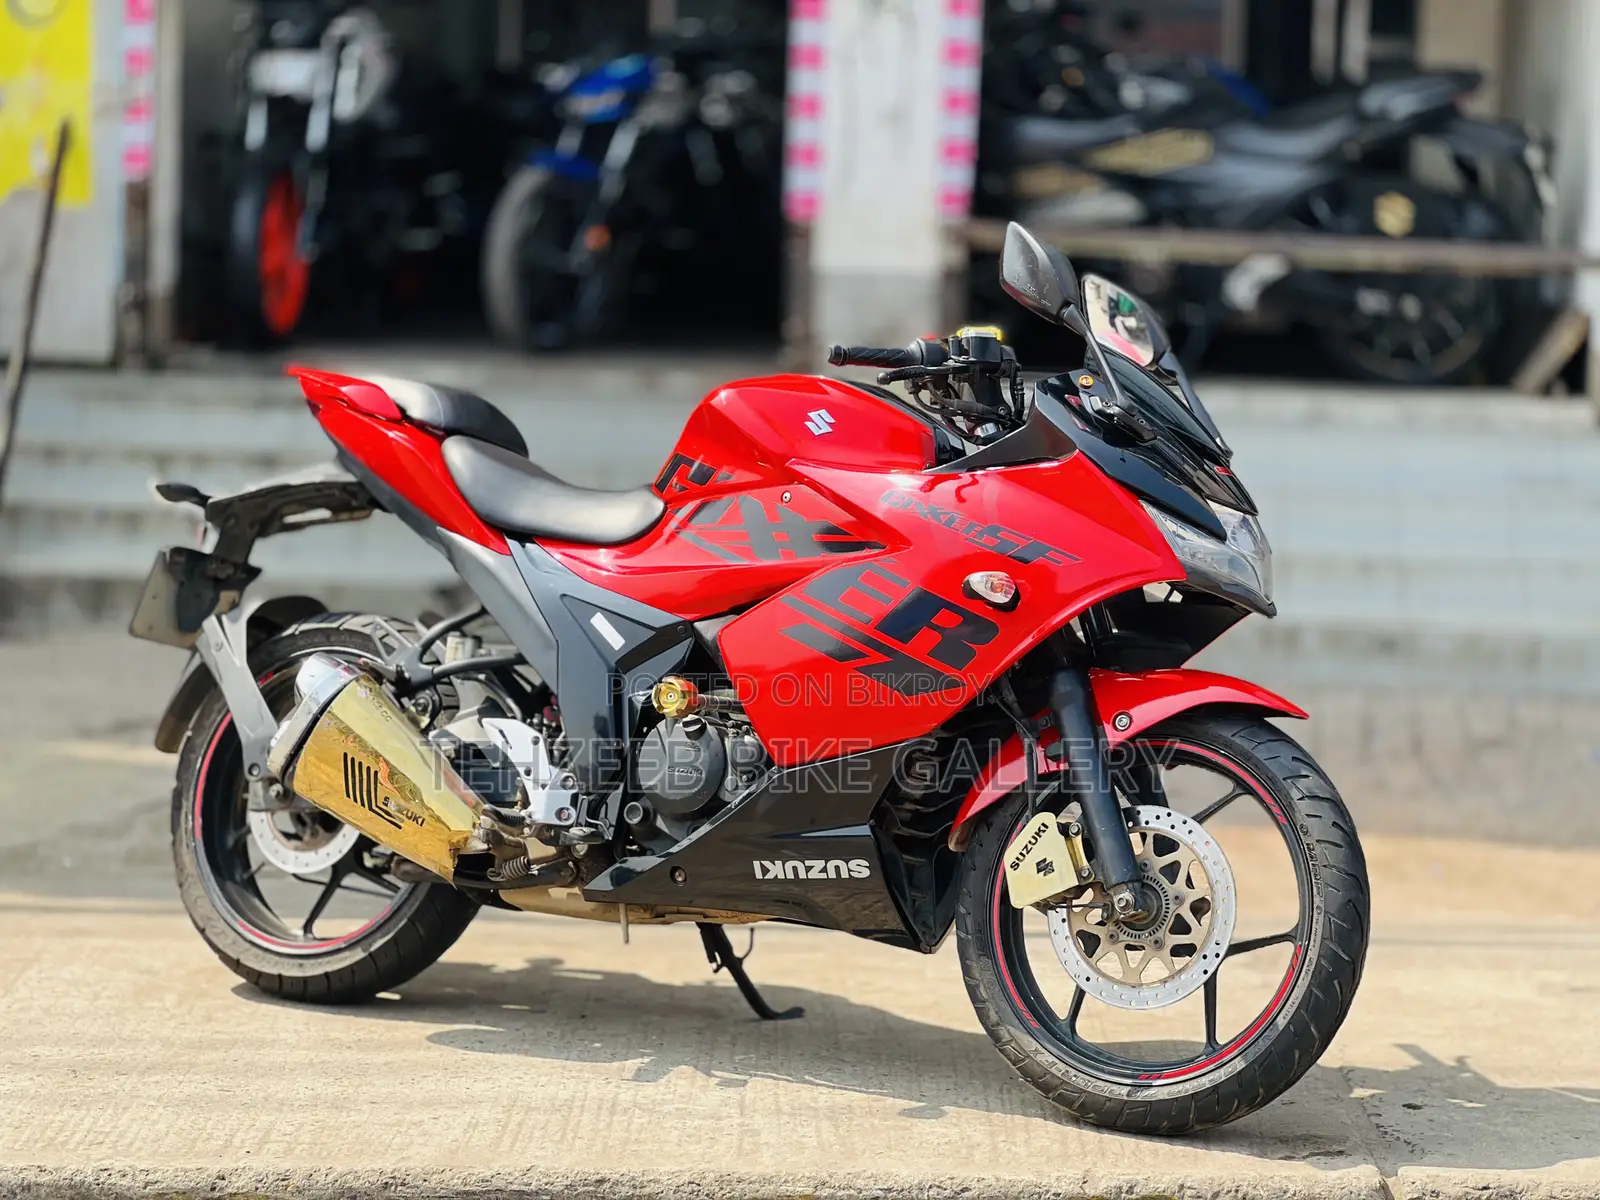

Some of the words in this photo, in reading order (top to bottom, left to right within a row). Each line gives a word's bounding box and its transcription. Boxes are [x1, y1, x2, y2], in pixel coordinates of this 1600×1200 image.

[964, 522, 1083, 566] SF
[381, 795, 426, 828] SZUKI
[1009, 822, 1050, 872] SUZUKI
[752, 858, 871, 880] SUZUKI
